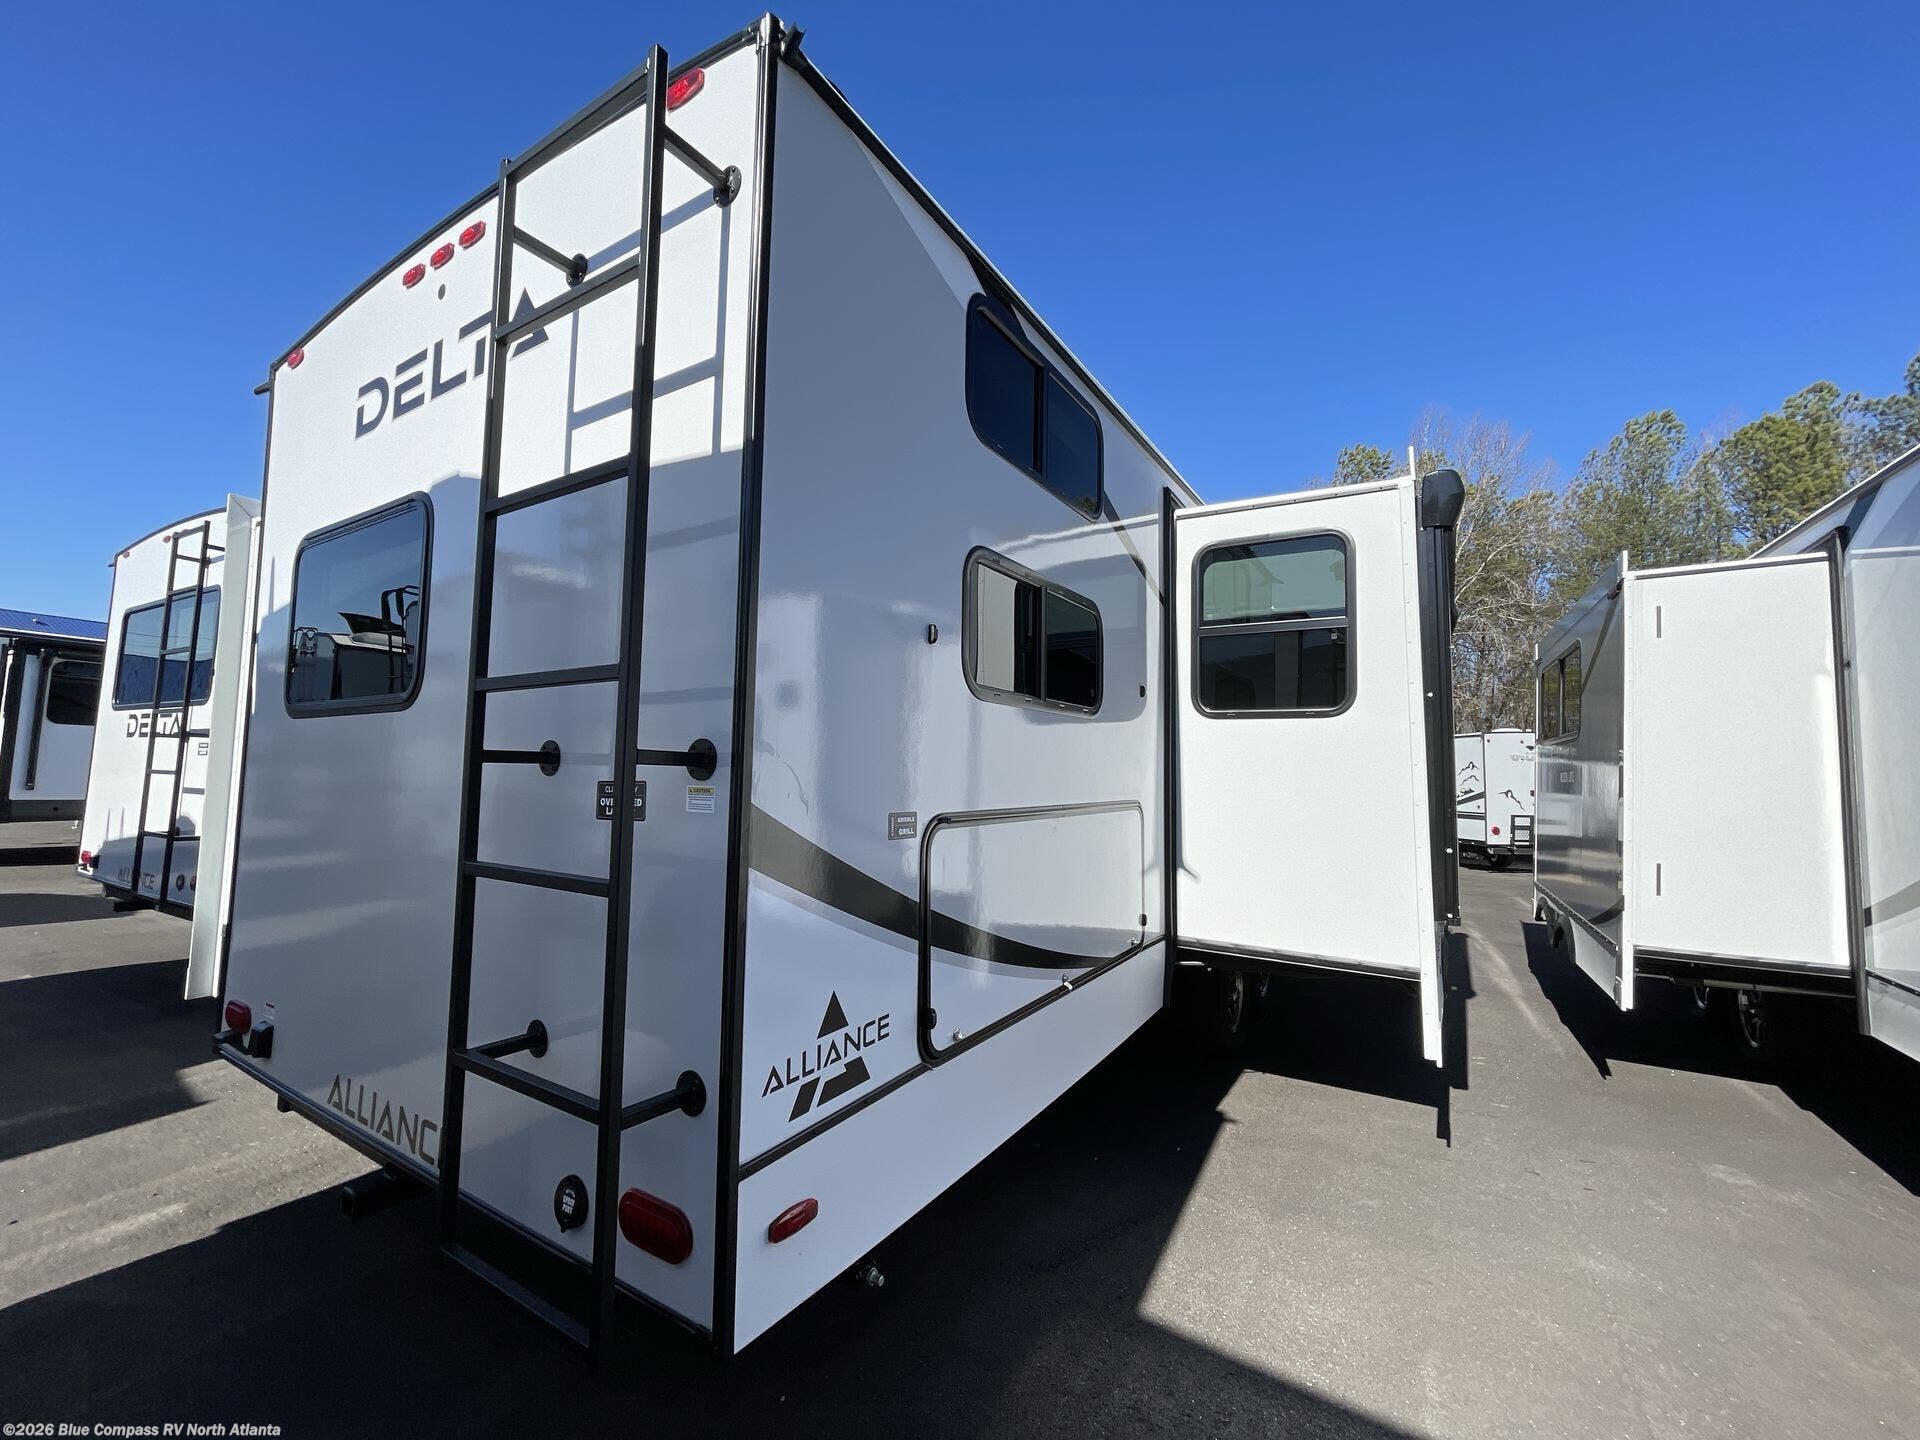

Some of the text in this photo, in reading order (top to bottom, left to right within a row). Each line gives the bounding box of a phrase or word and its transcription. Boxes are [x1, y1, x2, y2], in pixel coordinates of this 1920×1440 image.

[126, 712, 183, 738] DETA
[761, 1013, 890, 1099] ALLIANCE
[326, 1073, 439, 1165] ALLIANC
